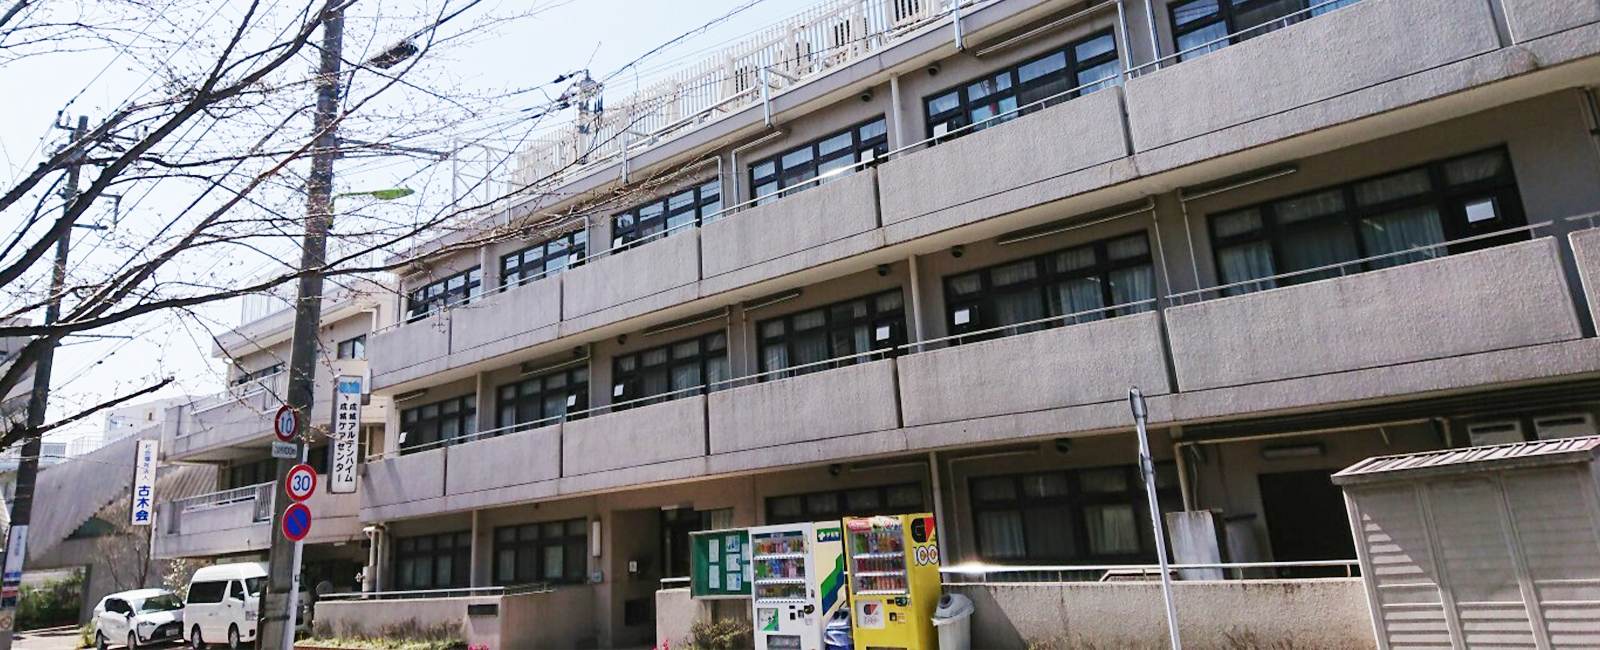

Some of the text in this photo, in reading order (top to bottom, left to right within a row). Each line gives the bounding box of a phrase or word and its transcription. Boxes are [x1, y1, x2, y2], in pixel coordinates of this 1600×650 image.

[280, 416, 293, 434] 10
[336, 402, 348, 483] 成城ケアセンター
[292, 474, 311, 492] 30
[135, 485, 151, 522] 古木会
[912, 543, 939, 567] 100
